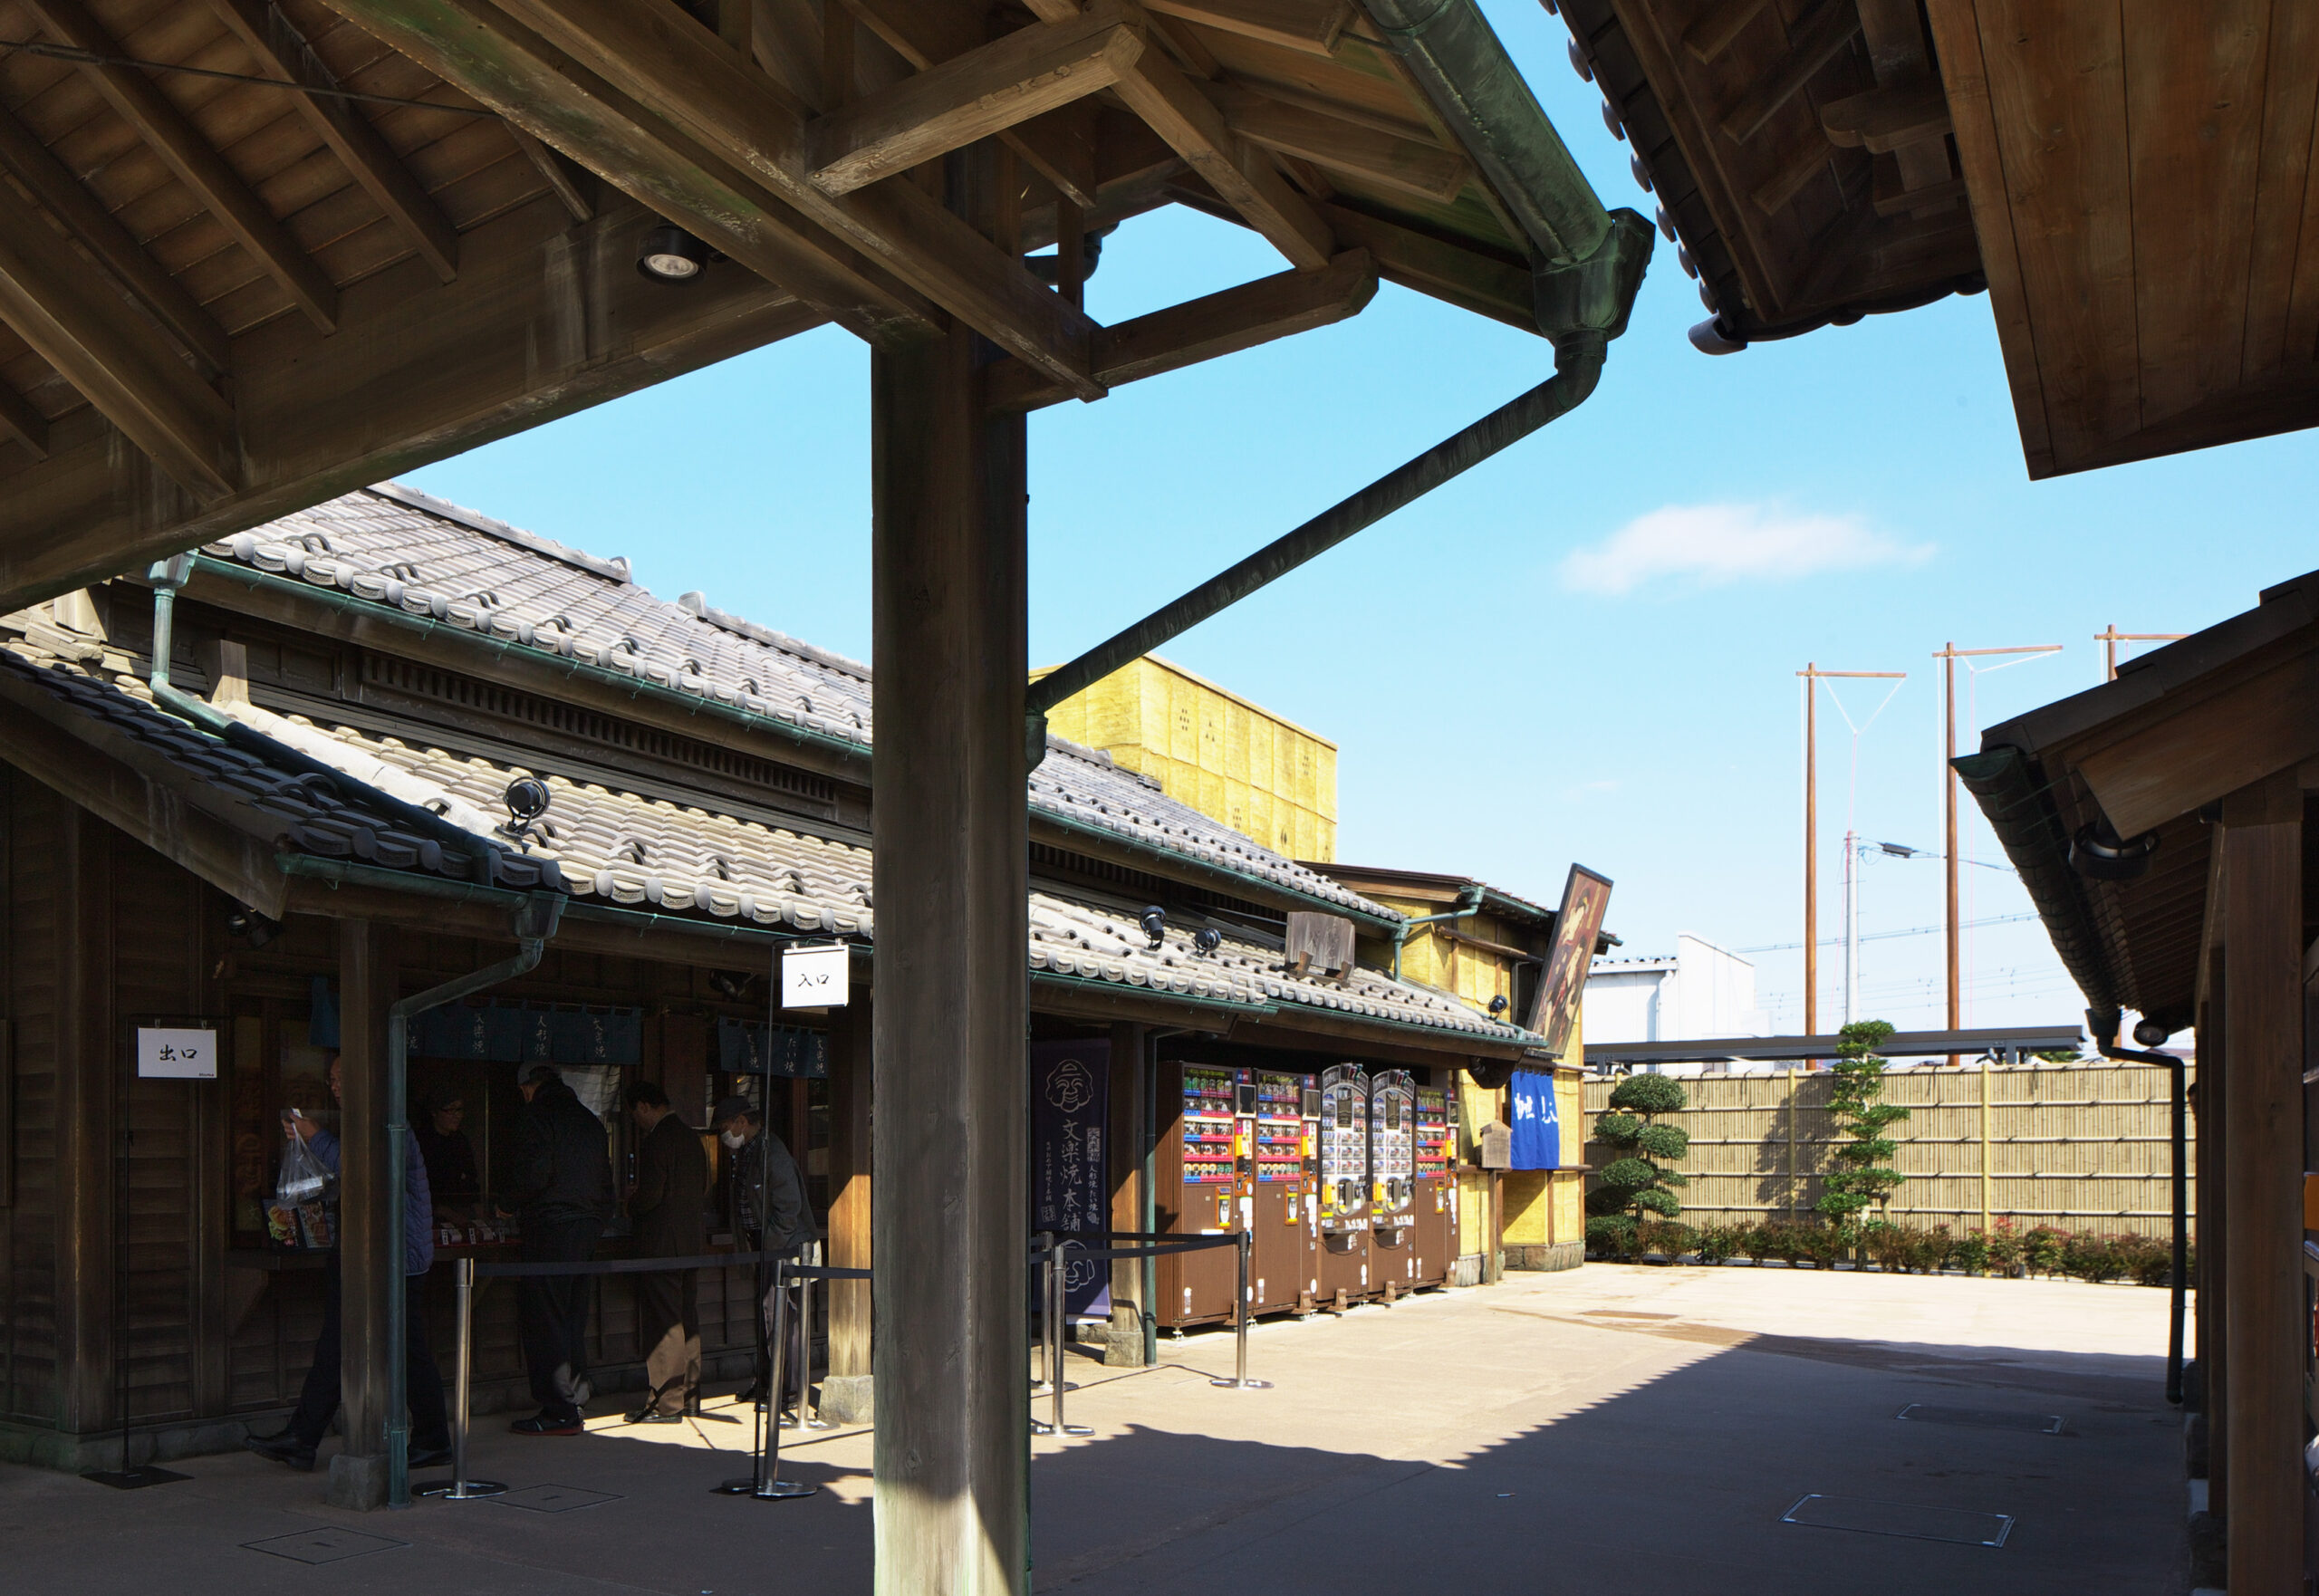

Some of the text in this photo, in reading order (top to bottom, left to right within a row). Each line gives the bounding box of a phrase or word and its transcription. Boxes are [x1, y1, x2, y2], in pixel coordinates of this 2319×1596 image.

[797, 973, 830, 987] 入口
[159, 1043, 197, 1062] 出口
[1060, 1119, 1083, 1232] 文楽焼本舗
